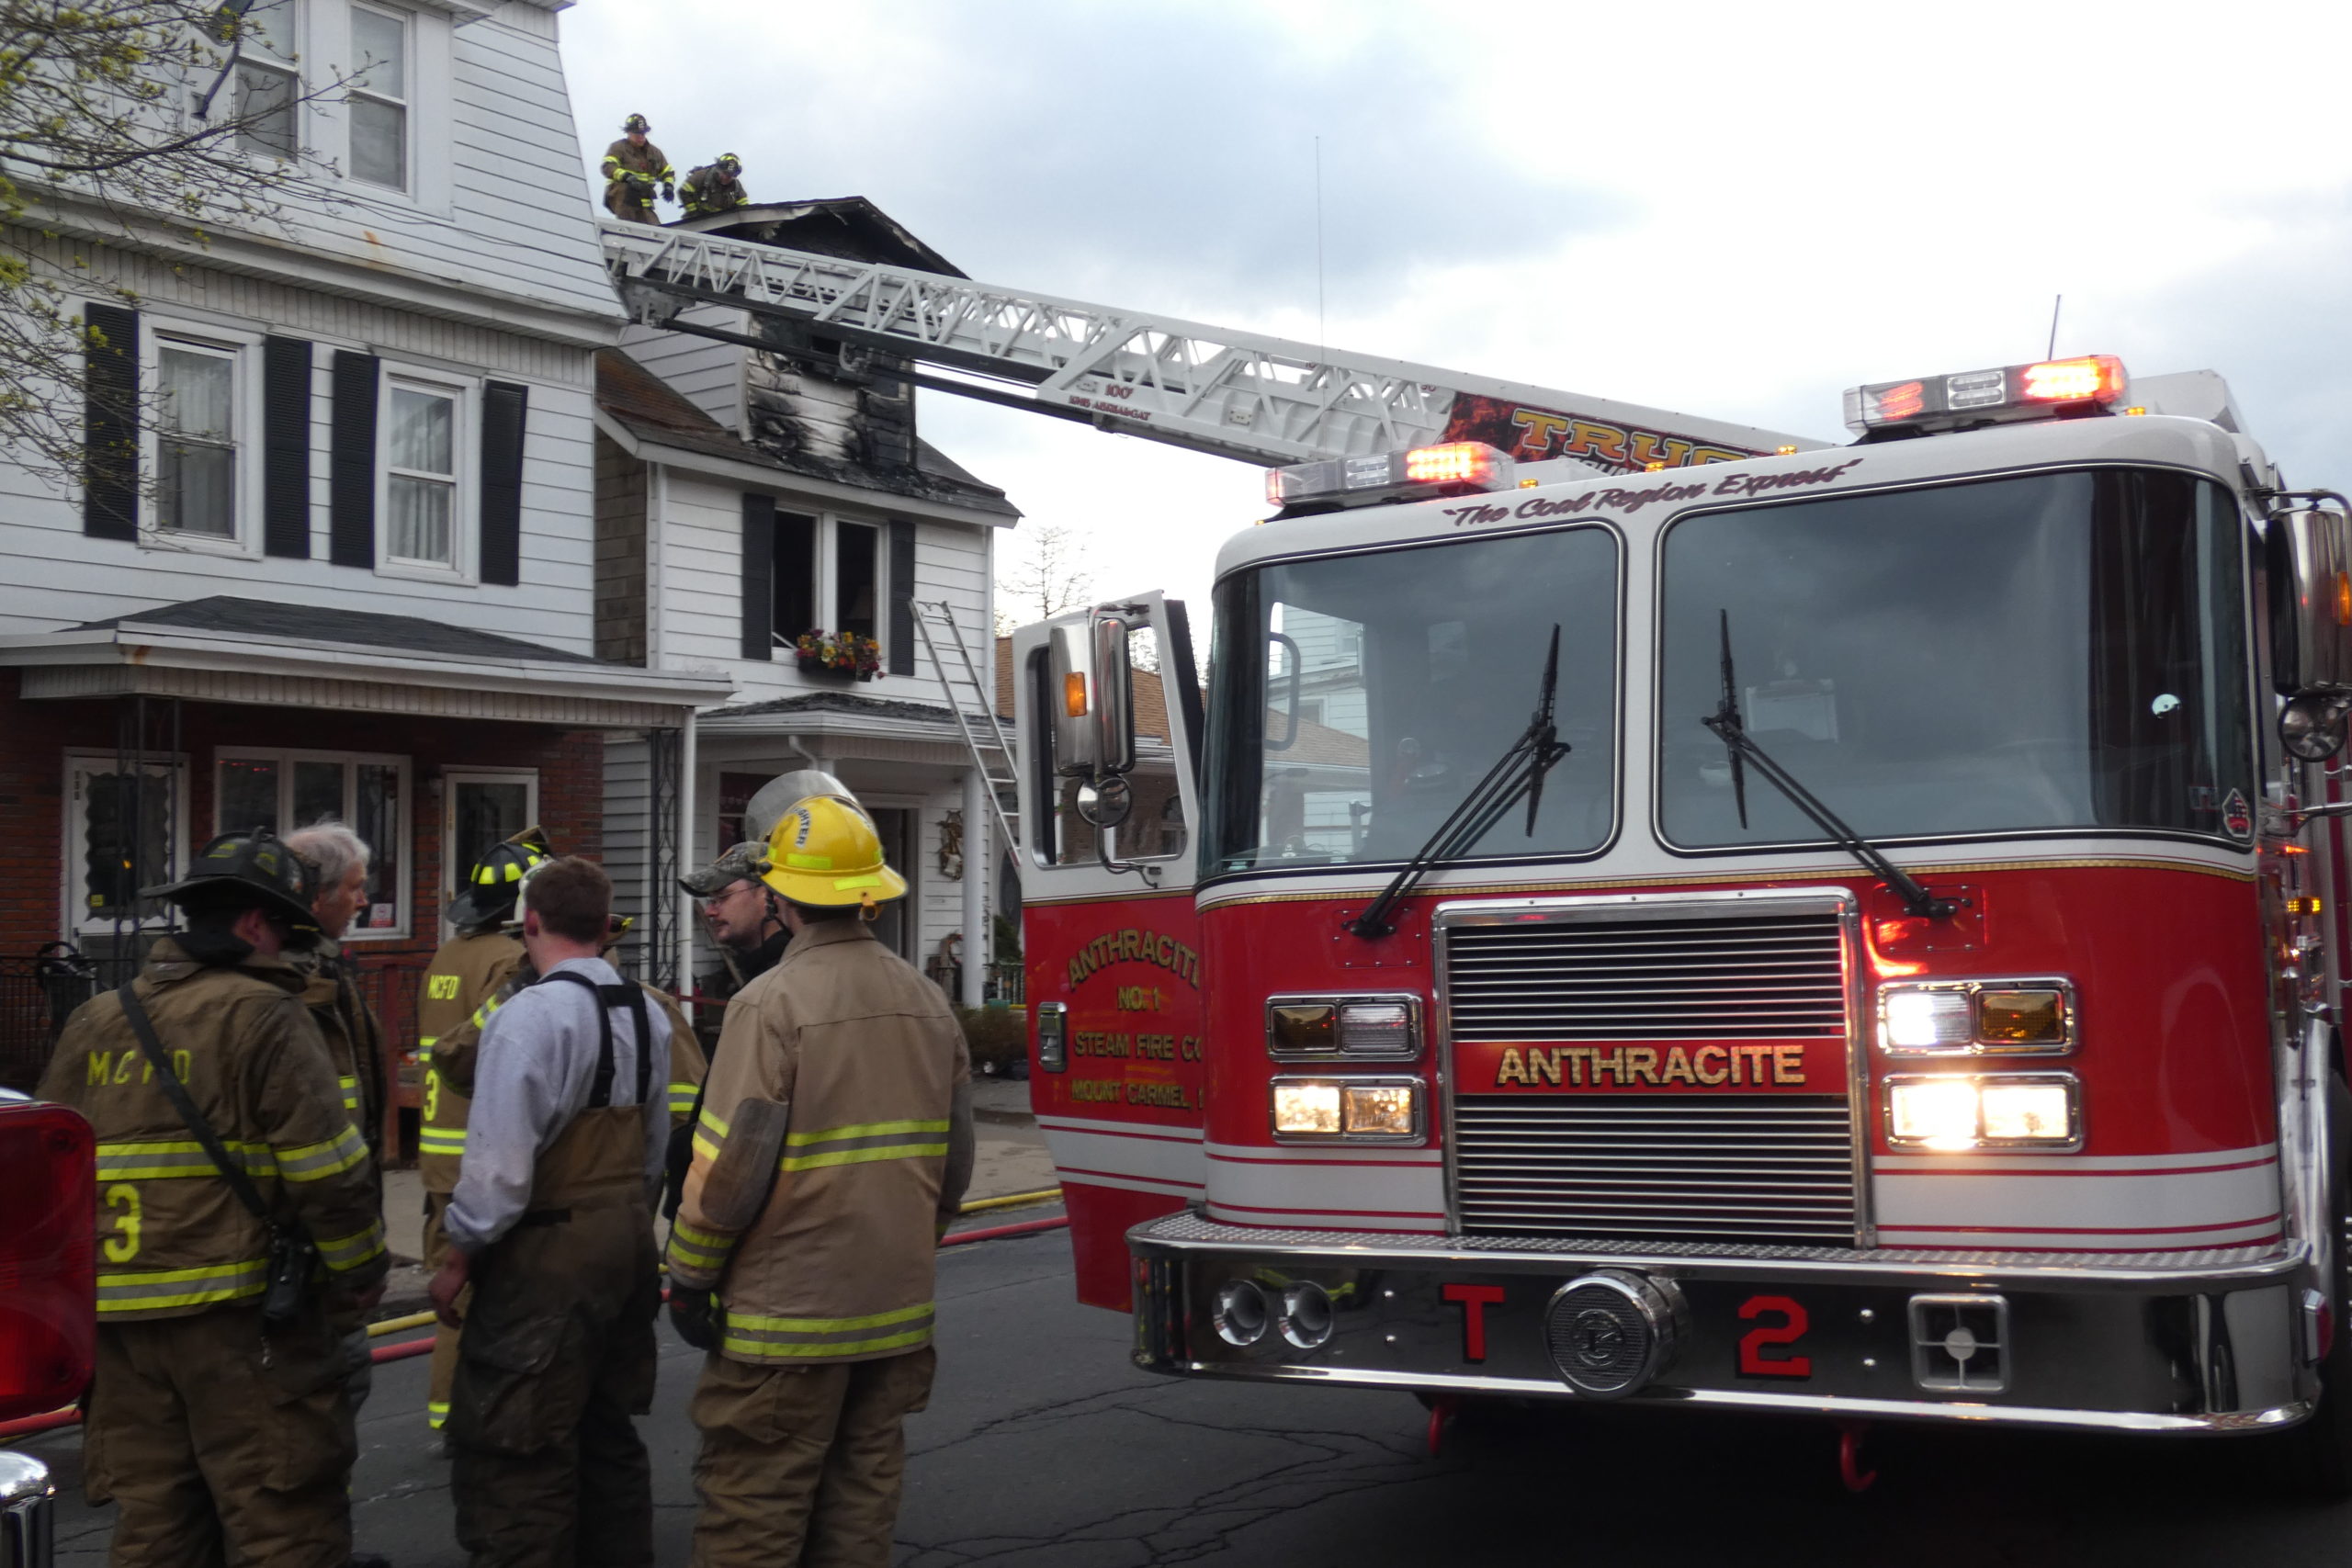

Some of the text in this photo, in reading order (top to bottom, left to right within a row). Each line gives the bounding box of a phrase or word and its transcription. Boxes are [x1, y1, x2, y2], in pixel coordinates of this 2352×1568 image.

[1514, 491, 1595, 519] Coal
[1594, 481, 1707, 513] Region
[1713, 458, 1863, 497] Express
[427, 975, 461, 999] MCFD
[1075, 1032, 1130, 1057] STEAM
[1136, 1033, 1174, 1060] FIRE
[1497, 1044, 1806, 1087] ANTHRACITE
[423, 1068, 440, 1122] 3
[1070, 1079, 1122, 1103] MOUNT
[103, 1184, 142, 1265] 3
[1442, 1283, 1505, 1362] T
[1737, 1295, 1811, 1376] 2
